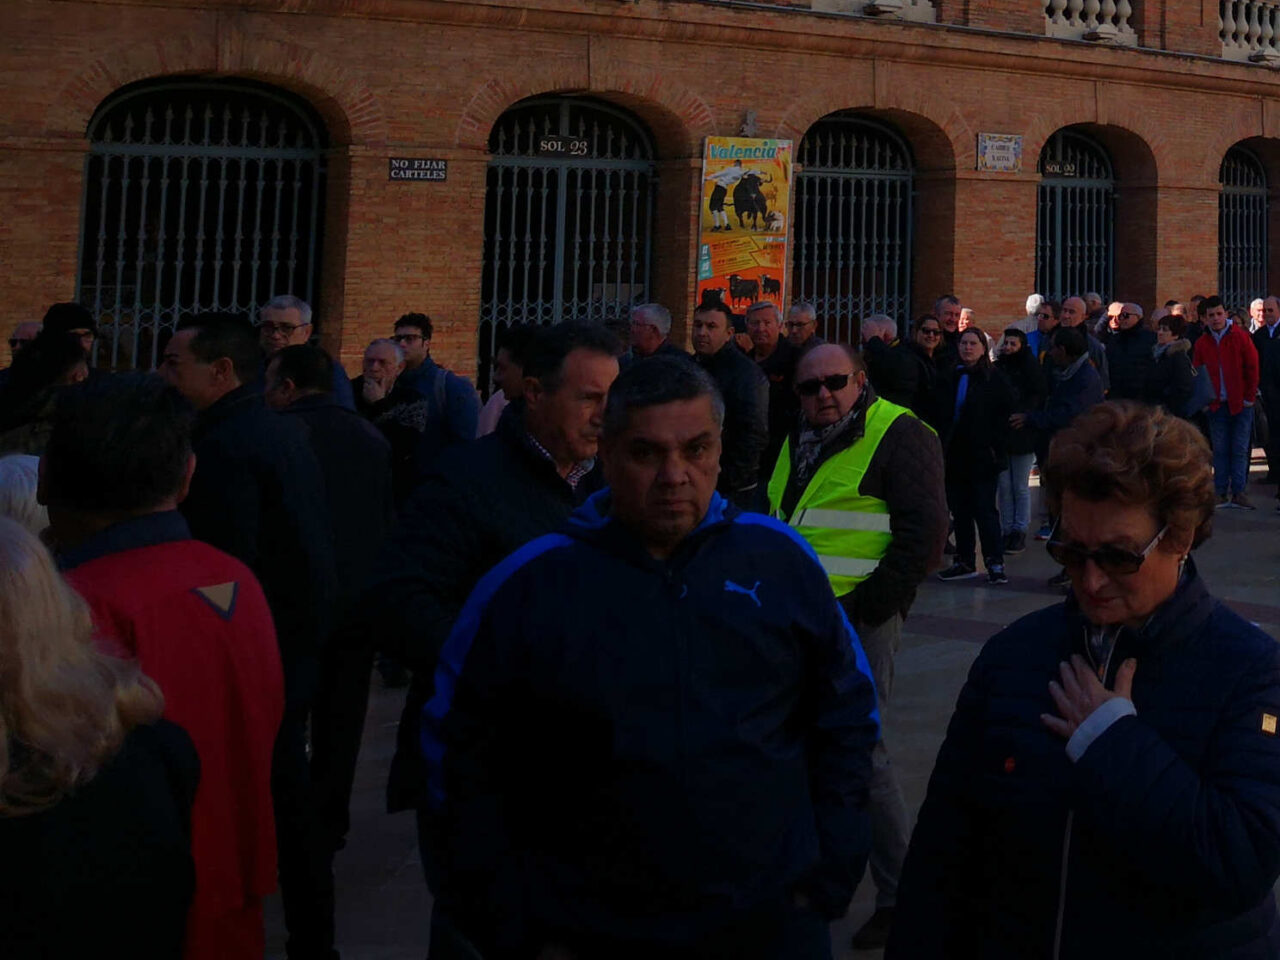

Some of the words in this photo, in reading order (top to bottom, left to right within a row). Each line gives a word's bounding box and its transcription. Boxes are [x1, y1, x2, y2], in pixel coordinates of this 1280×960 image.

[540, 140, 565, 152] SOL
[709, 142, 777, 159] Valencia
[391, 159, 409, 169] NO
[413, 160, 446, 170] FIJAR
[391, 169, 446, 179] CARTELES
